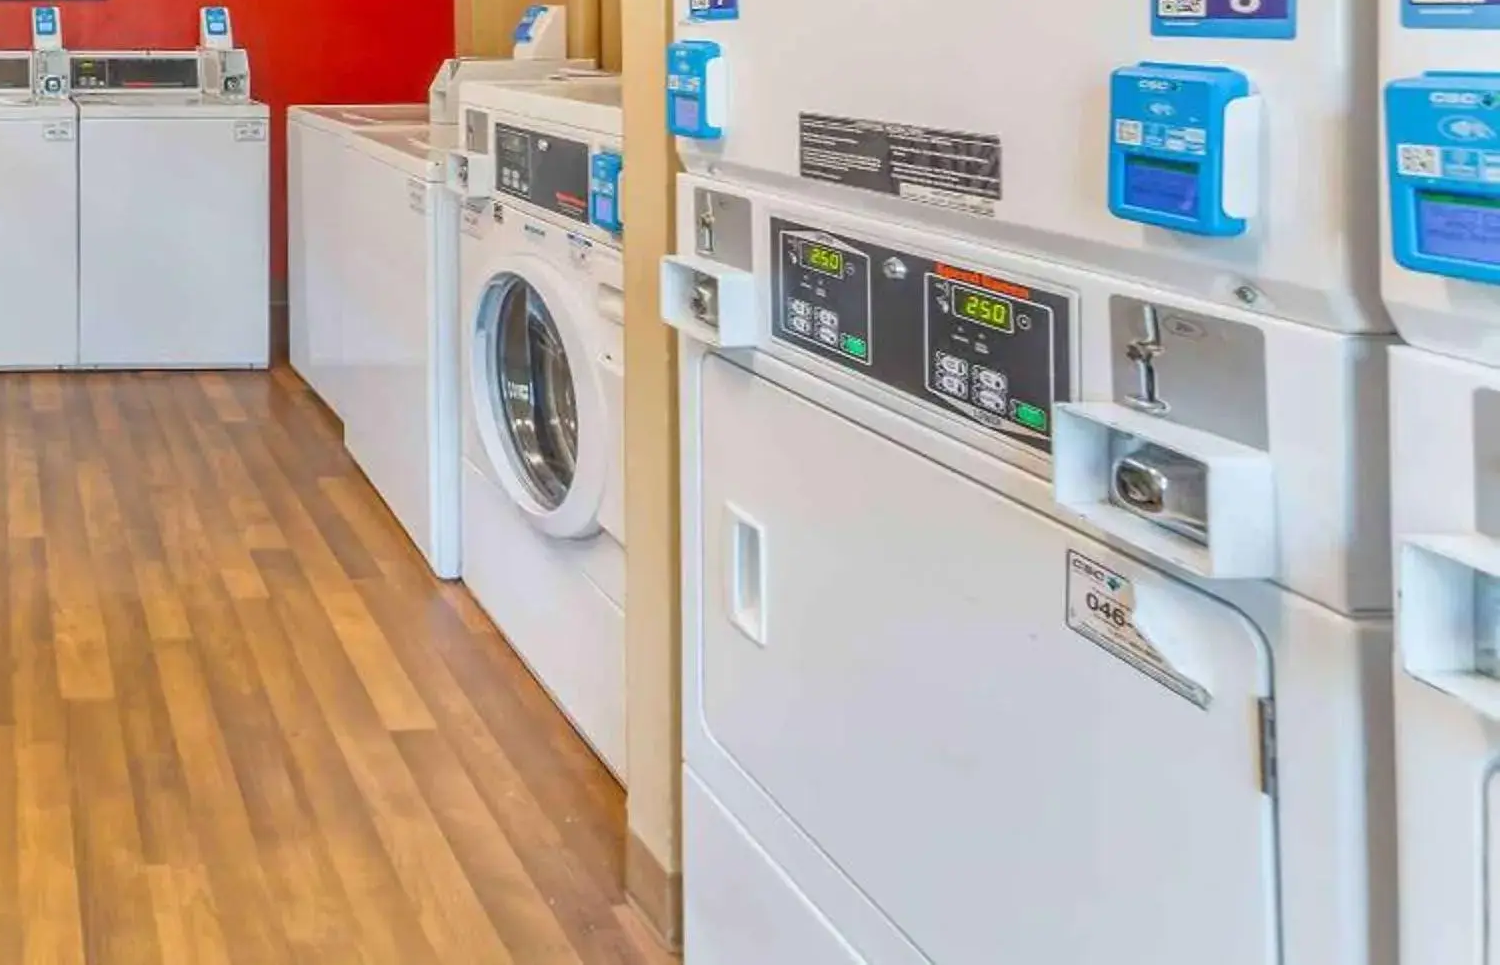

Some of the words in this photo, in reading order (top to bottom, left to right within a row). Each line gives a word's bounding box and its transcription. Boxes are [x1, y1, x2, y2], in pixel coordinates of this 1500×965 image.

[965, 296, 1006, 324] 250
[1072, 558, 1105, 581] CSC
[1086, 592, 1136, 630] 046-
